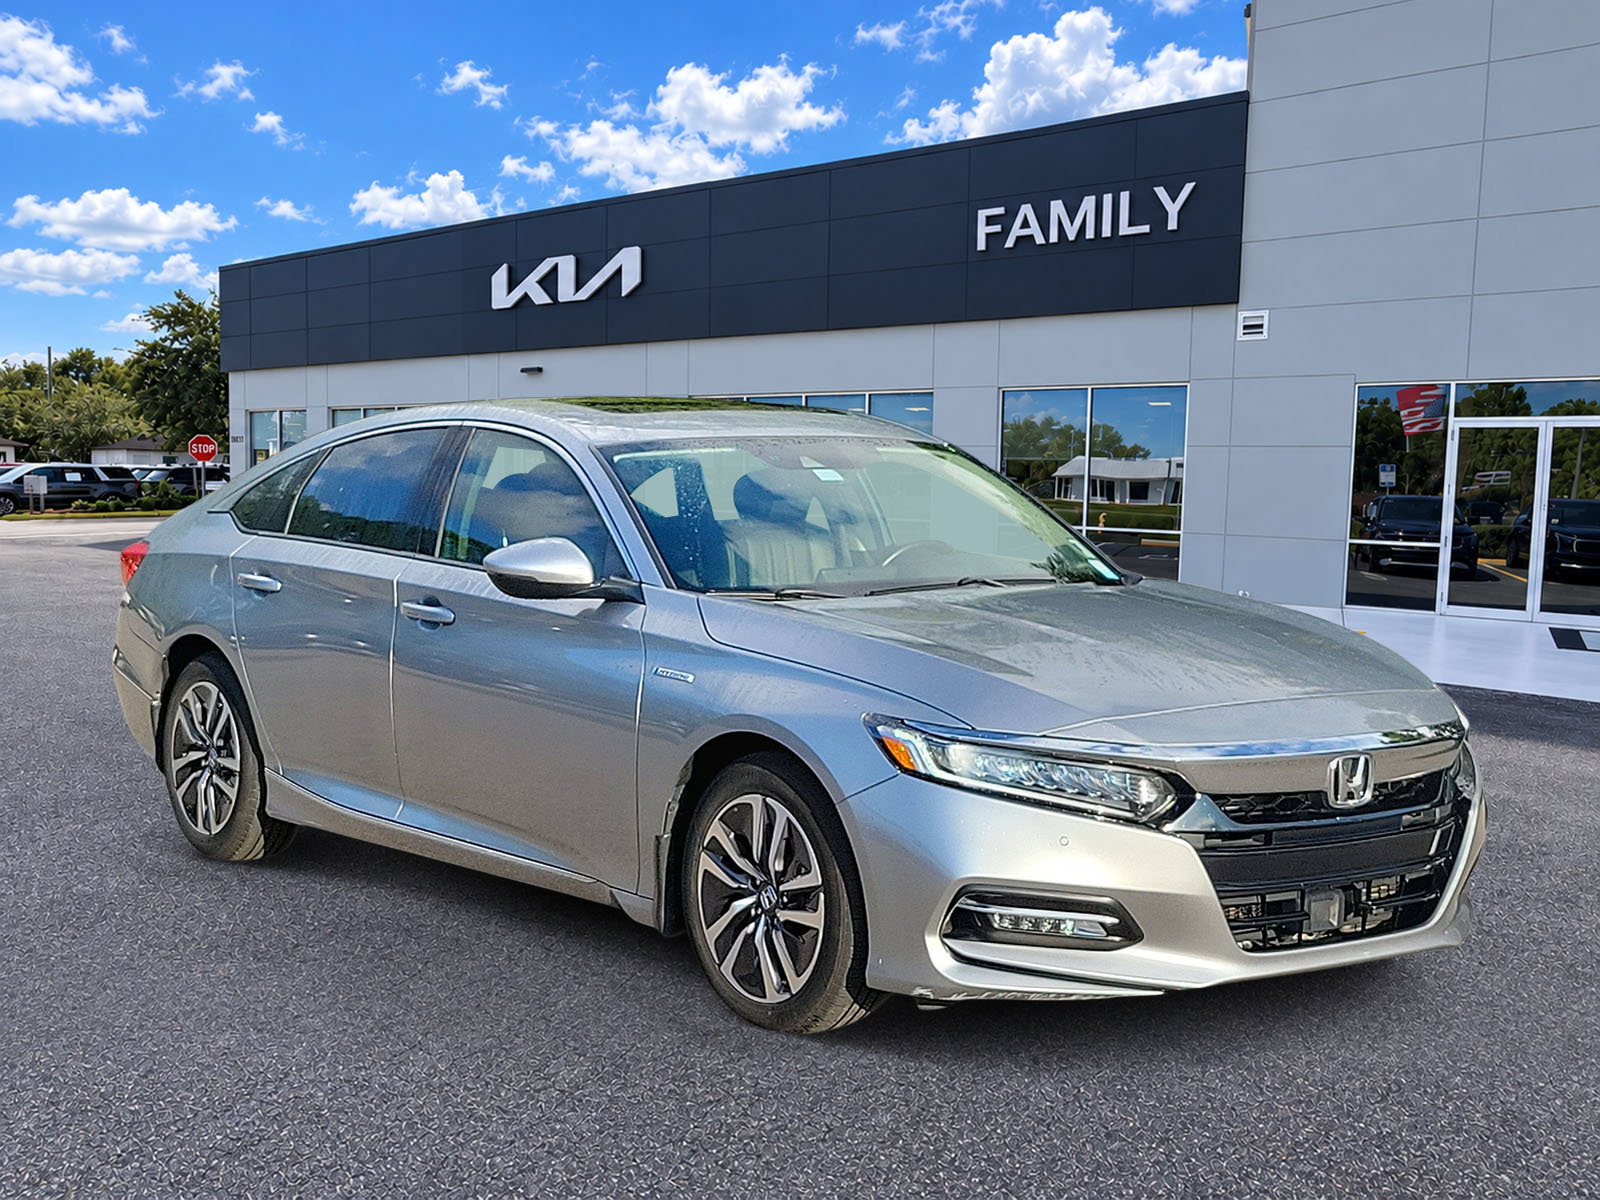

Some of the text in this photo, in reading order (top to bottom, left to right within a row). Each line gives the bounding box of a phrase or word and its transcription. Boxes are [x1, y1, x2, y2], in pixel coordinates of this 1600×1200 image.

[976, 181, 1197, 252] FAMILY
[491, 245, 642, 310] KIA
[191, 443, 216, 454] STOP
